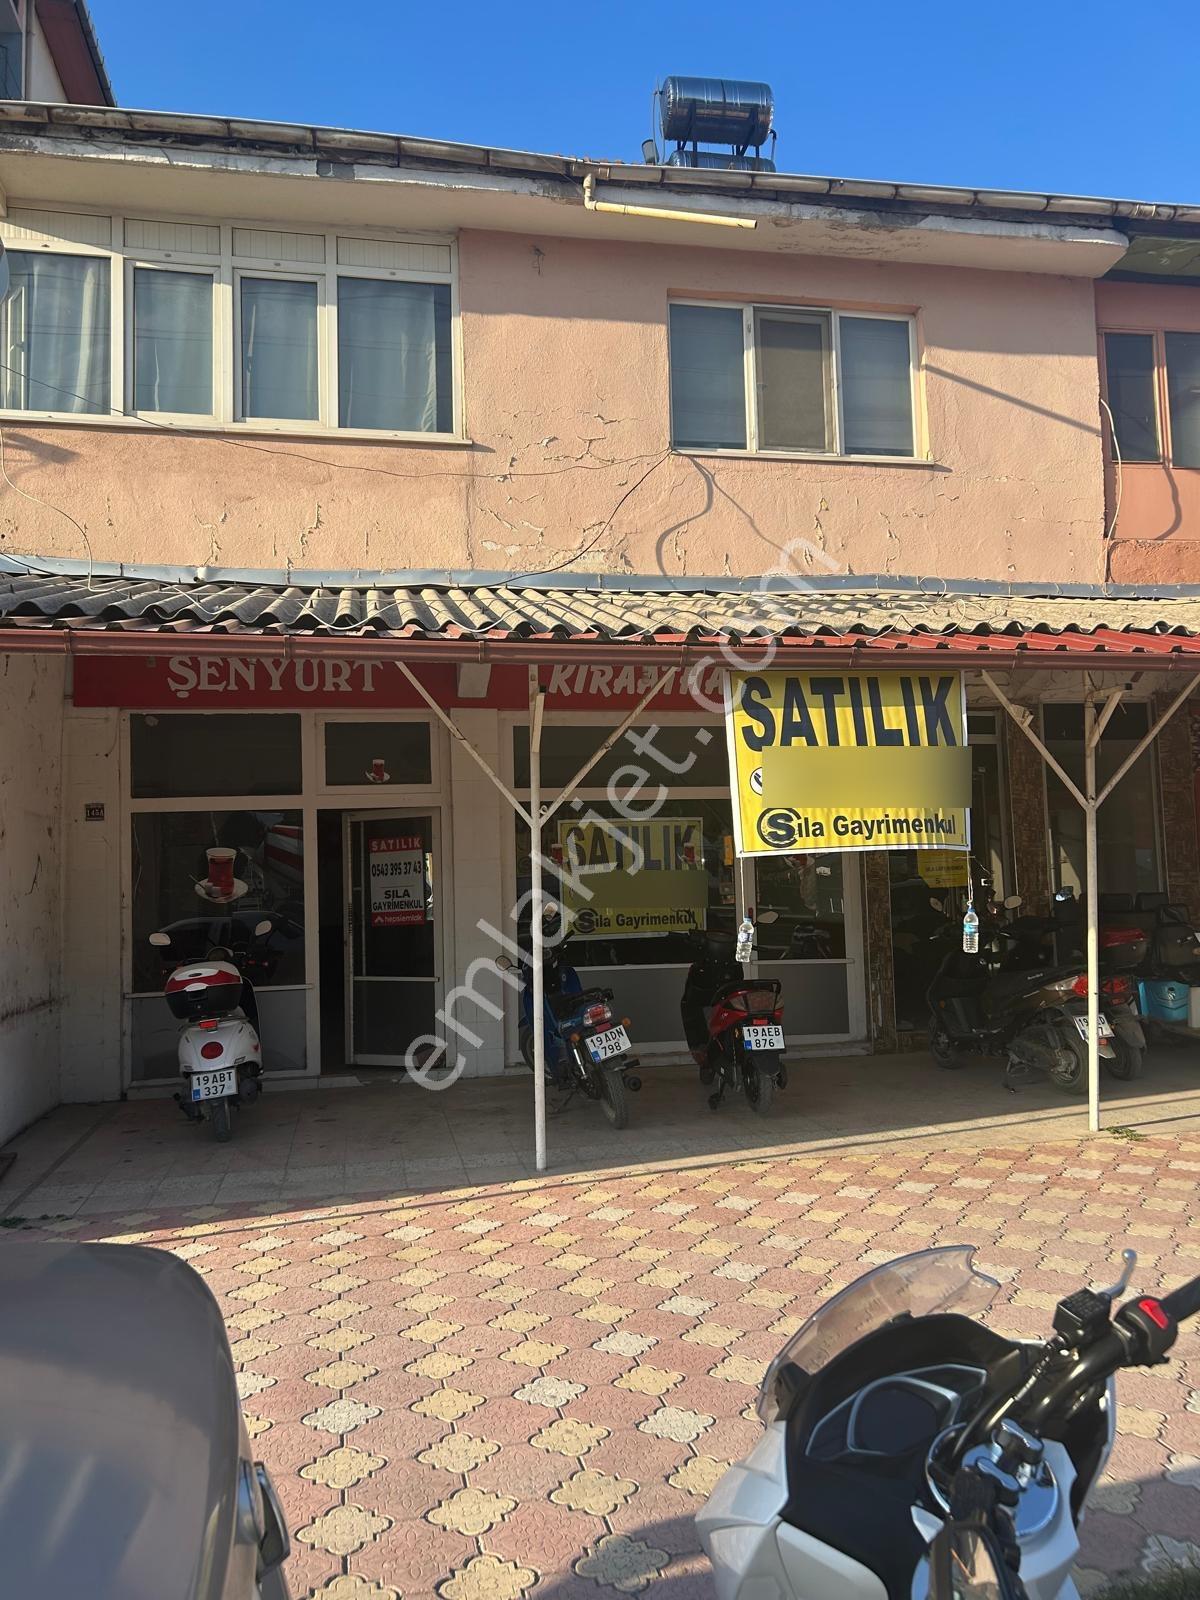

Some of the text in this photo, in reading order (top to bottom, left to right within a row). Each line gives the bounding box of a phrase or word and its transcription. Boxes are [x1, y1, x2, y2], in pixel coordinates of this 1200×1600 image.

[168, 656, 384, 699] ŞENYURT
[741, 676, 958, 752] SATILIK
[832, 812, 957, 841] Gayrimenkul
[372, 838, 420, 851] SATILIK
[566, 824, 698, 873] SATILIK
[372, 861, 421, 877] 0543 395 37 43
[384, 889, 410, 899] SILA
[590, 1027, 625, 1048] 19 ADN
[746, 1027, 781, 1038] 19 AEB
[601, 1041, 622, 1057] 798
[754, 1038, 775, 1048] 876
[196, 1072, 232, 1086] 19 ABT
[204, 1084, 225, 1096] 337
